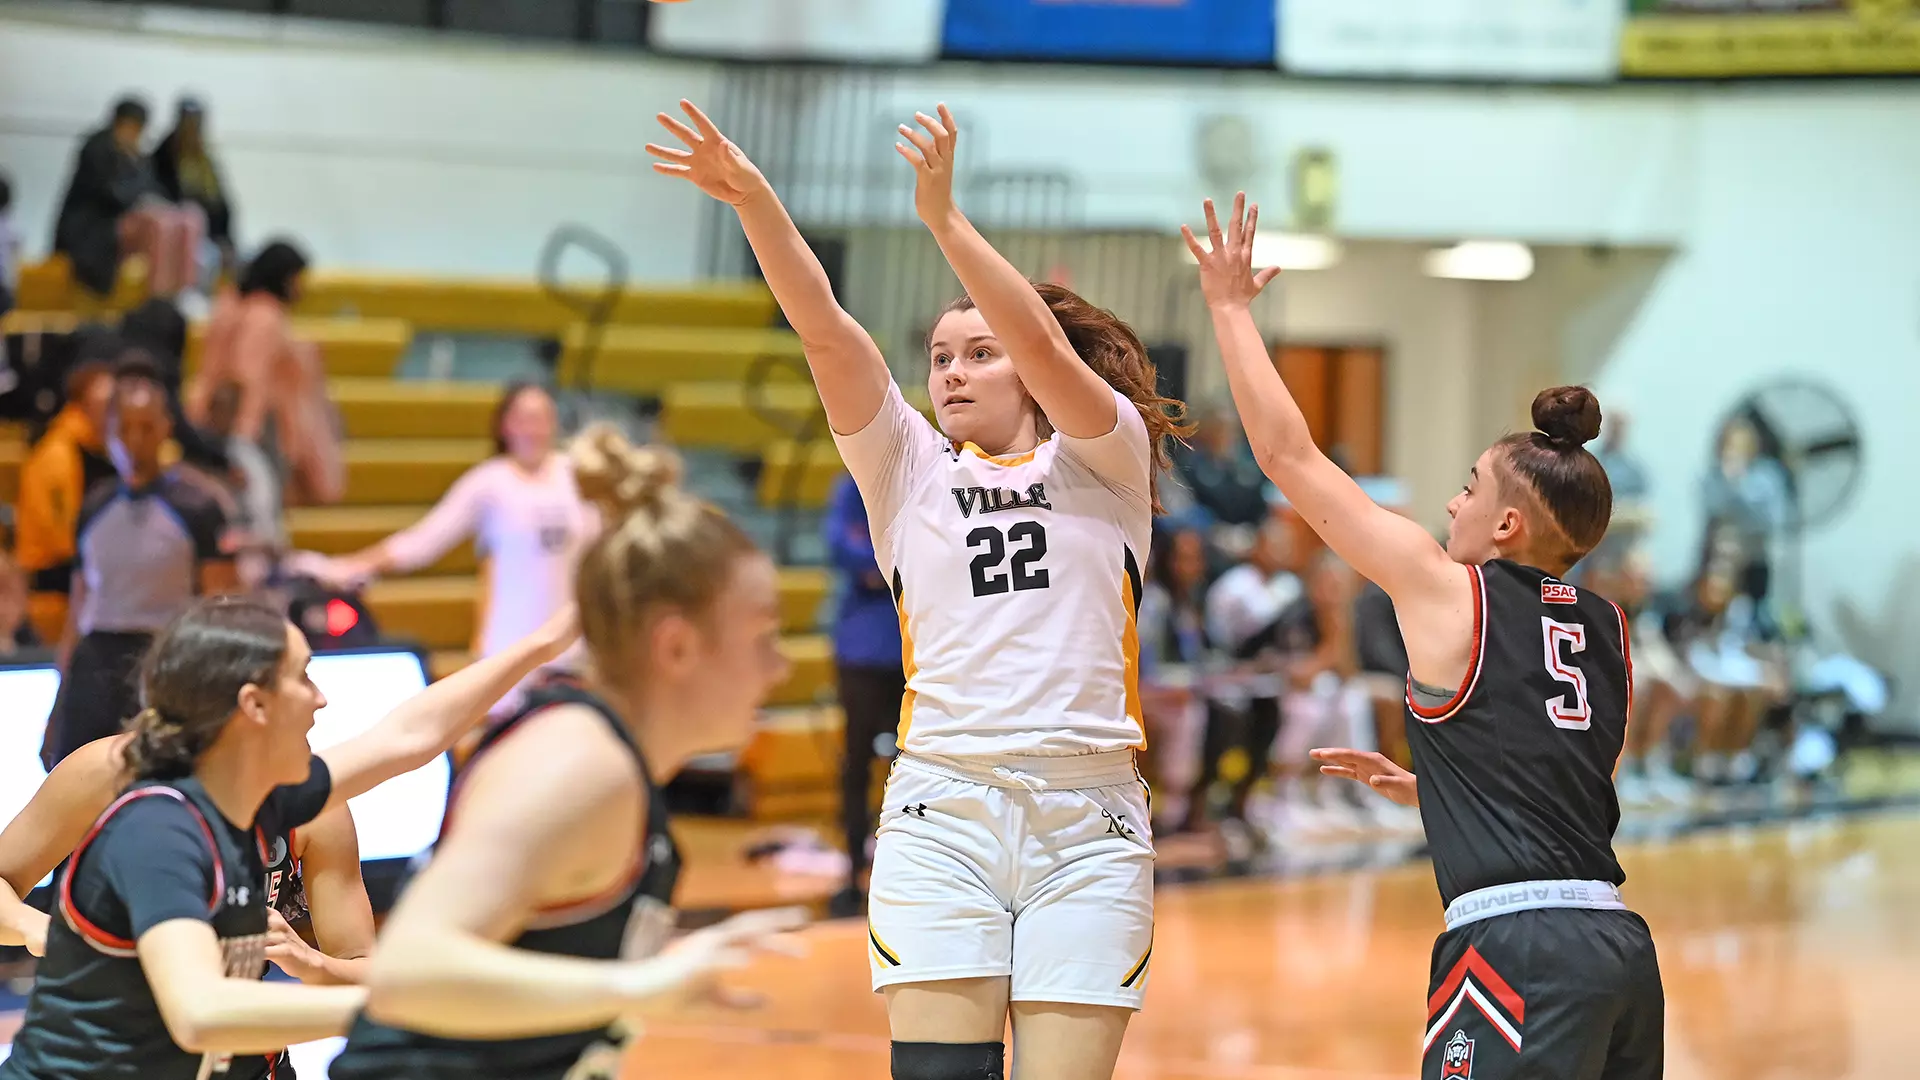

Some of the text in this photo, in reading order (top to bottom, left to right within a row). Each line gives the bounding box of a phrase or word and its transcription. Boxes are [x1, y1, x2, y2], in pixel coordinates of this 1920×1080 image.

[951, 482, 1052, 519] VILLE
[966, 520, 1050, 598] 22
[1542, 585, 1576, 597] PSAC
[1541, 615, 1592, 732] 5
